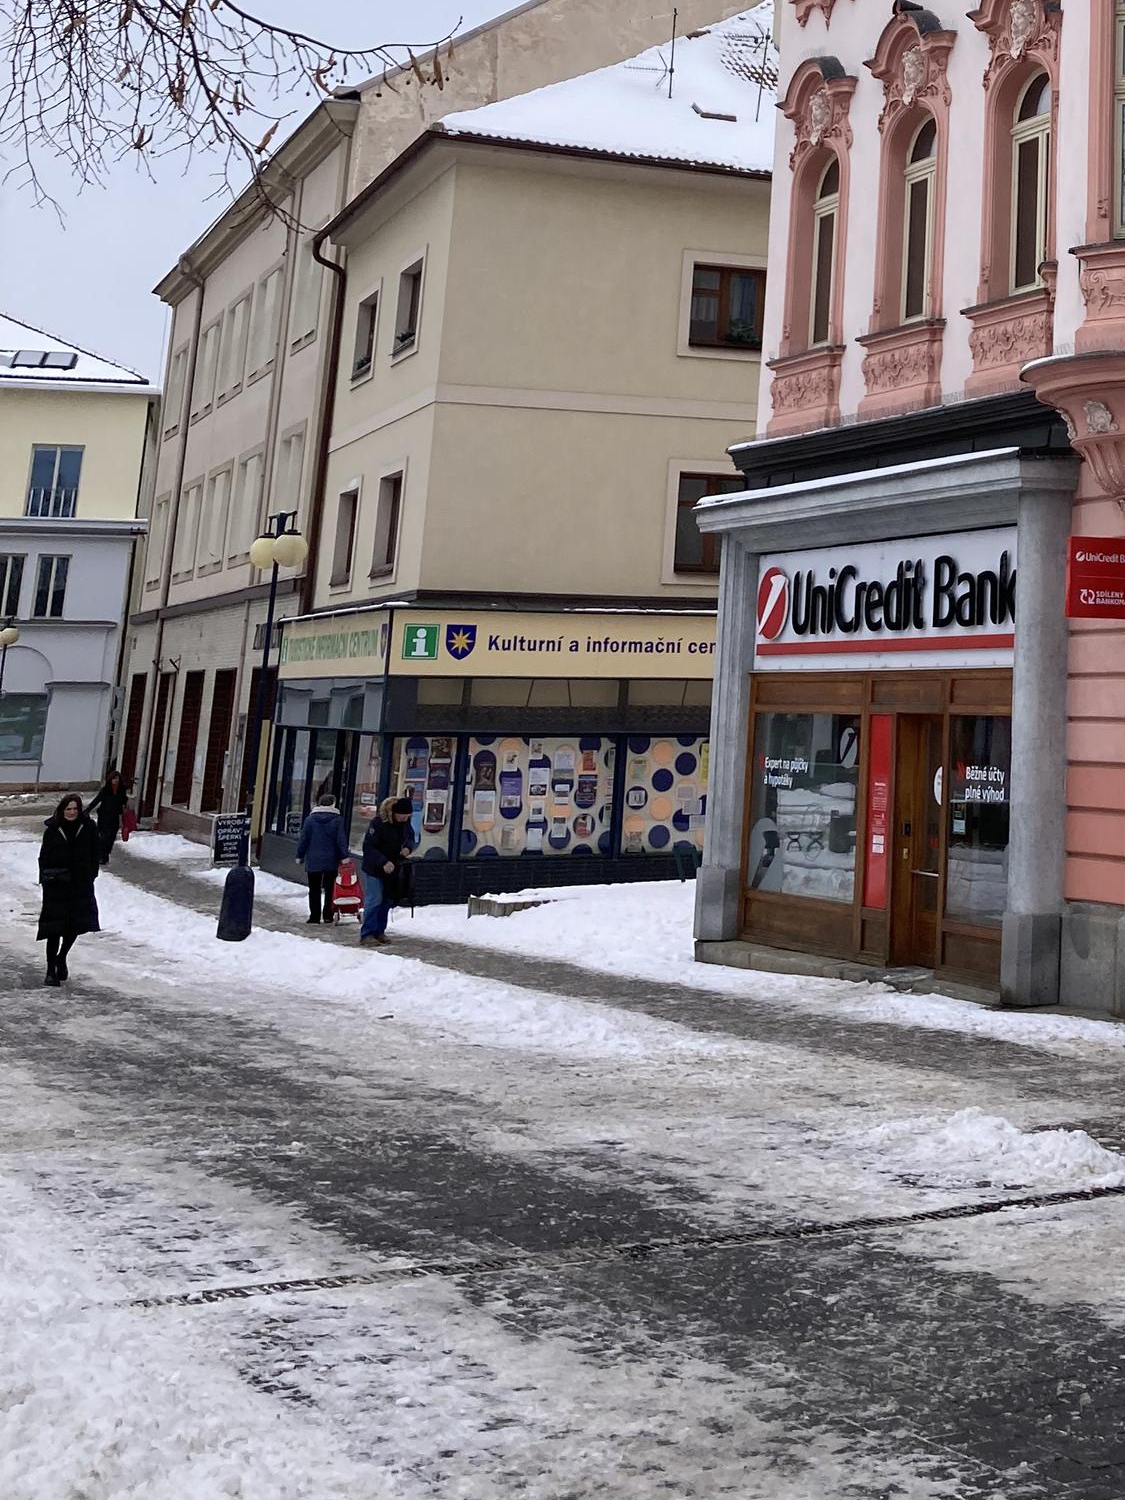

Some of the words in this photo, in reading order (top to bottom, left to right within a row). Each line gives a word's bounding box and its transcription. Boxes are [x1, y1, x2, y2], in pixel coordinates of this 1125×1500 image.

[1085, 552, 1119, 563] UniCredit
[791, 558, 926, 636] UniCredit
[932, 550, 1017, 628] Bank
[488, 635, 564, 652] Kulturní
[569, 640, 579, 652] a
[586, 636, 683, 654] informační
[765, 756, 783, 771] Expert
[783, 760, 790, 770] na
[965, 765, 988, 781] Běžné
[988, 766, 1005, 785] účty
[965, 785, 982, 801] plné
[982, 786, 1005, 803] výhod
